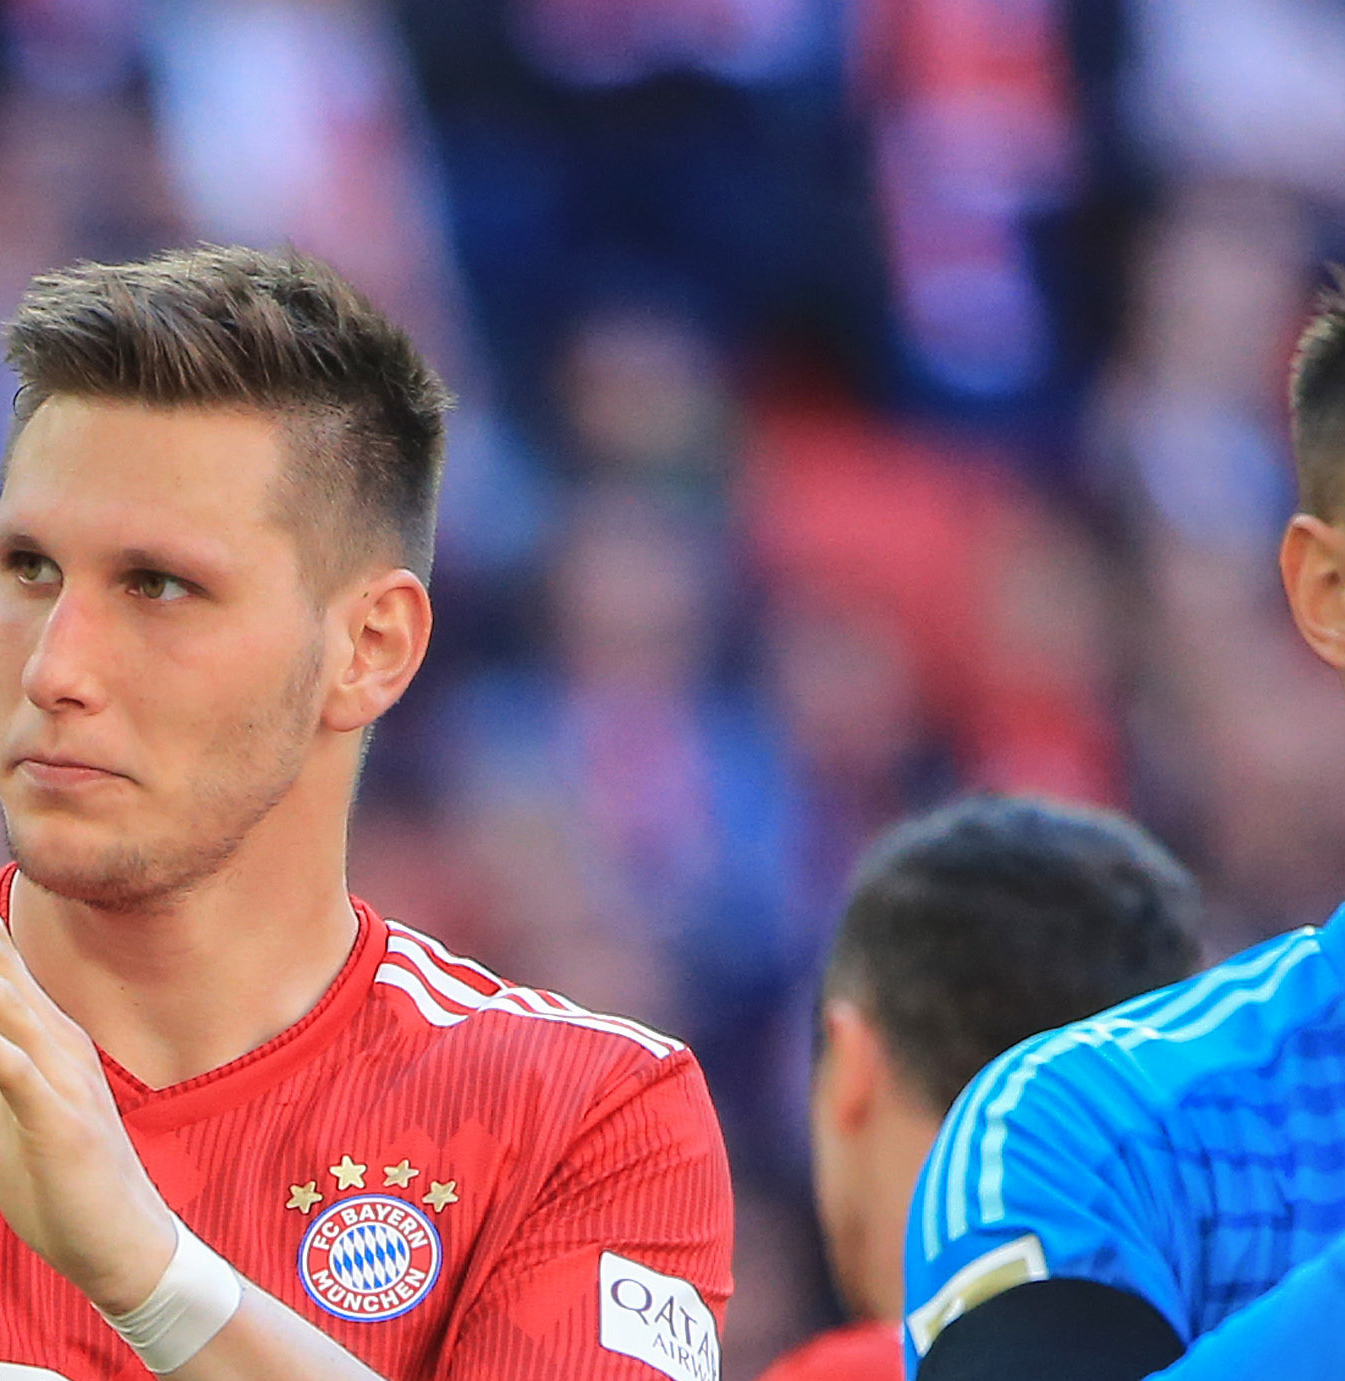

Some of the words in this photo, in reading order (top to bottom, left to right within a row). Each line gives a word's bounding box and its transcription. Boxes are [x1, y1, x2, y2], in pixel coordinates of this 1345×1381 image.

[313, 1222, 340, 1249] FC
[341, 1204, 427, 1248] BAYERN
[313, 1268, 426, 1312] MÜNCHEN
